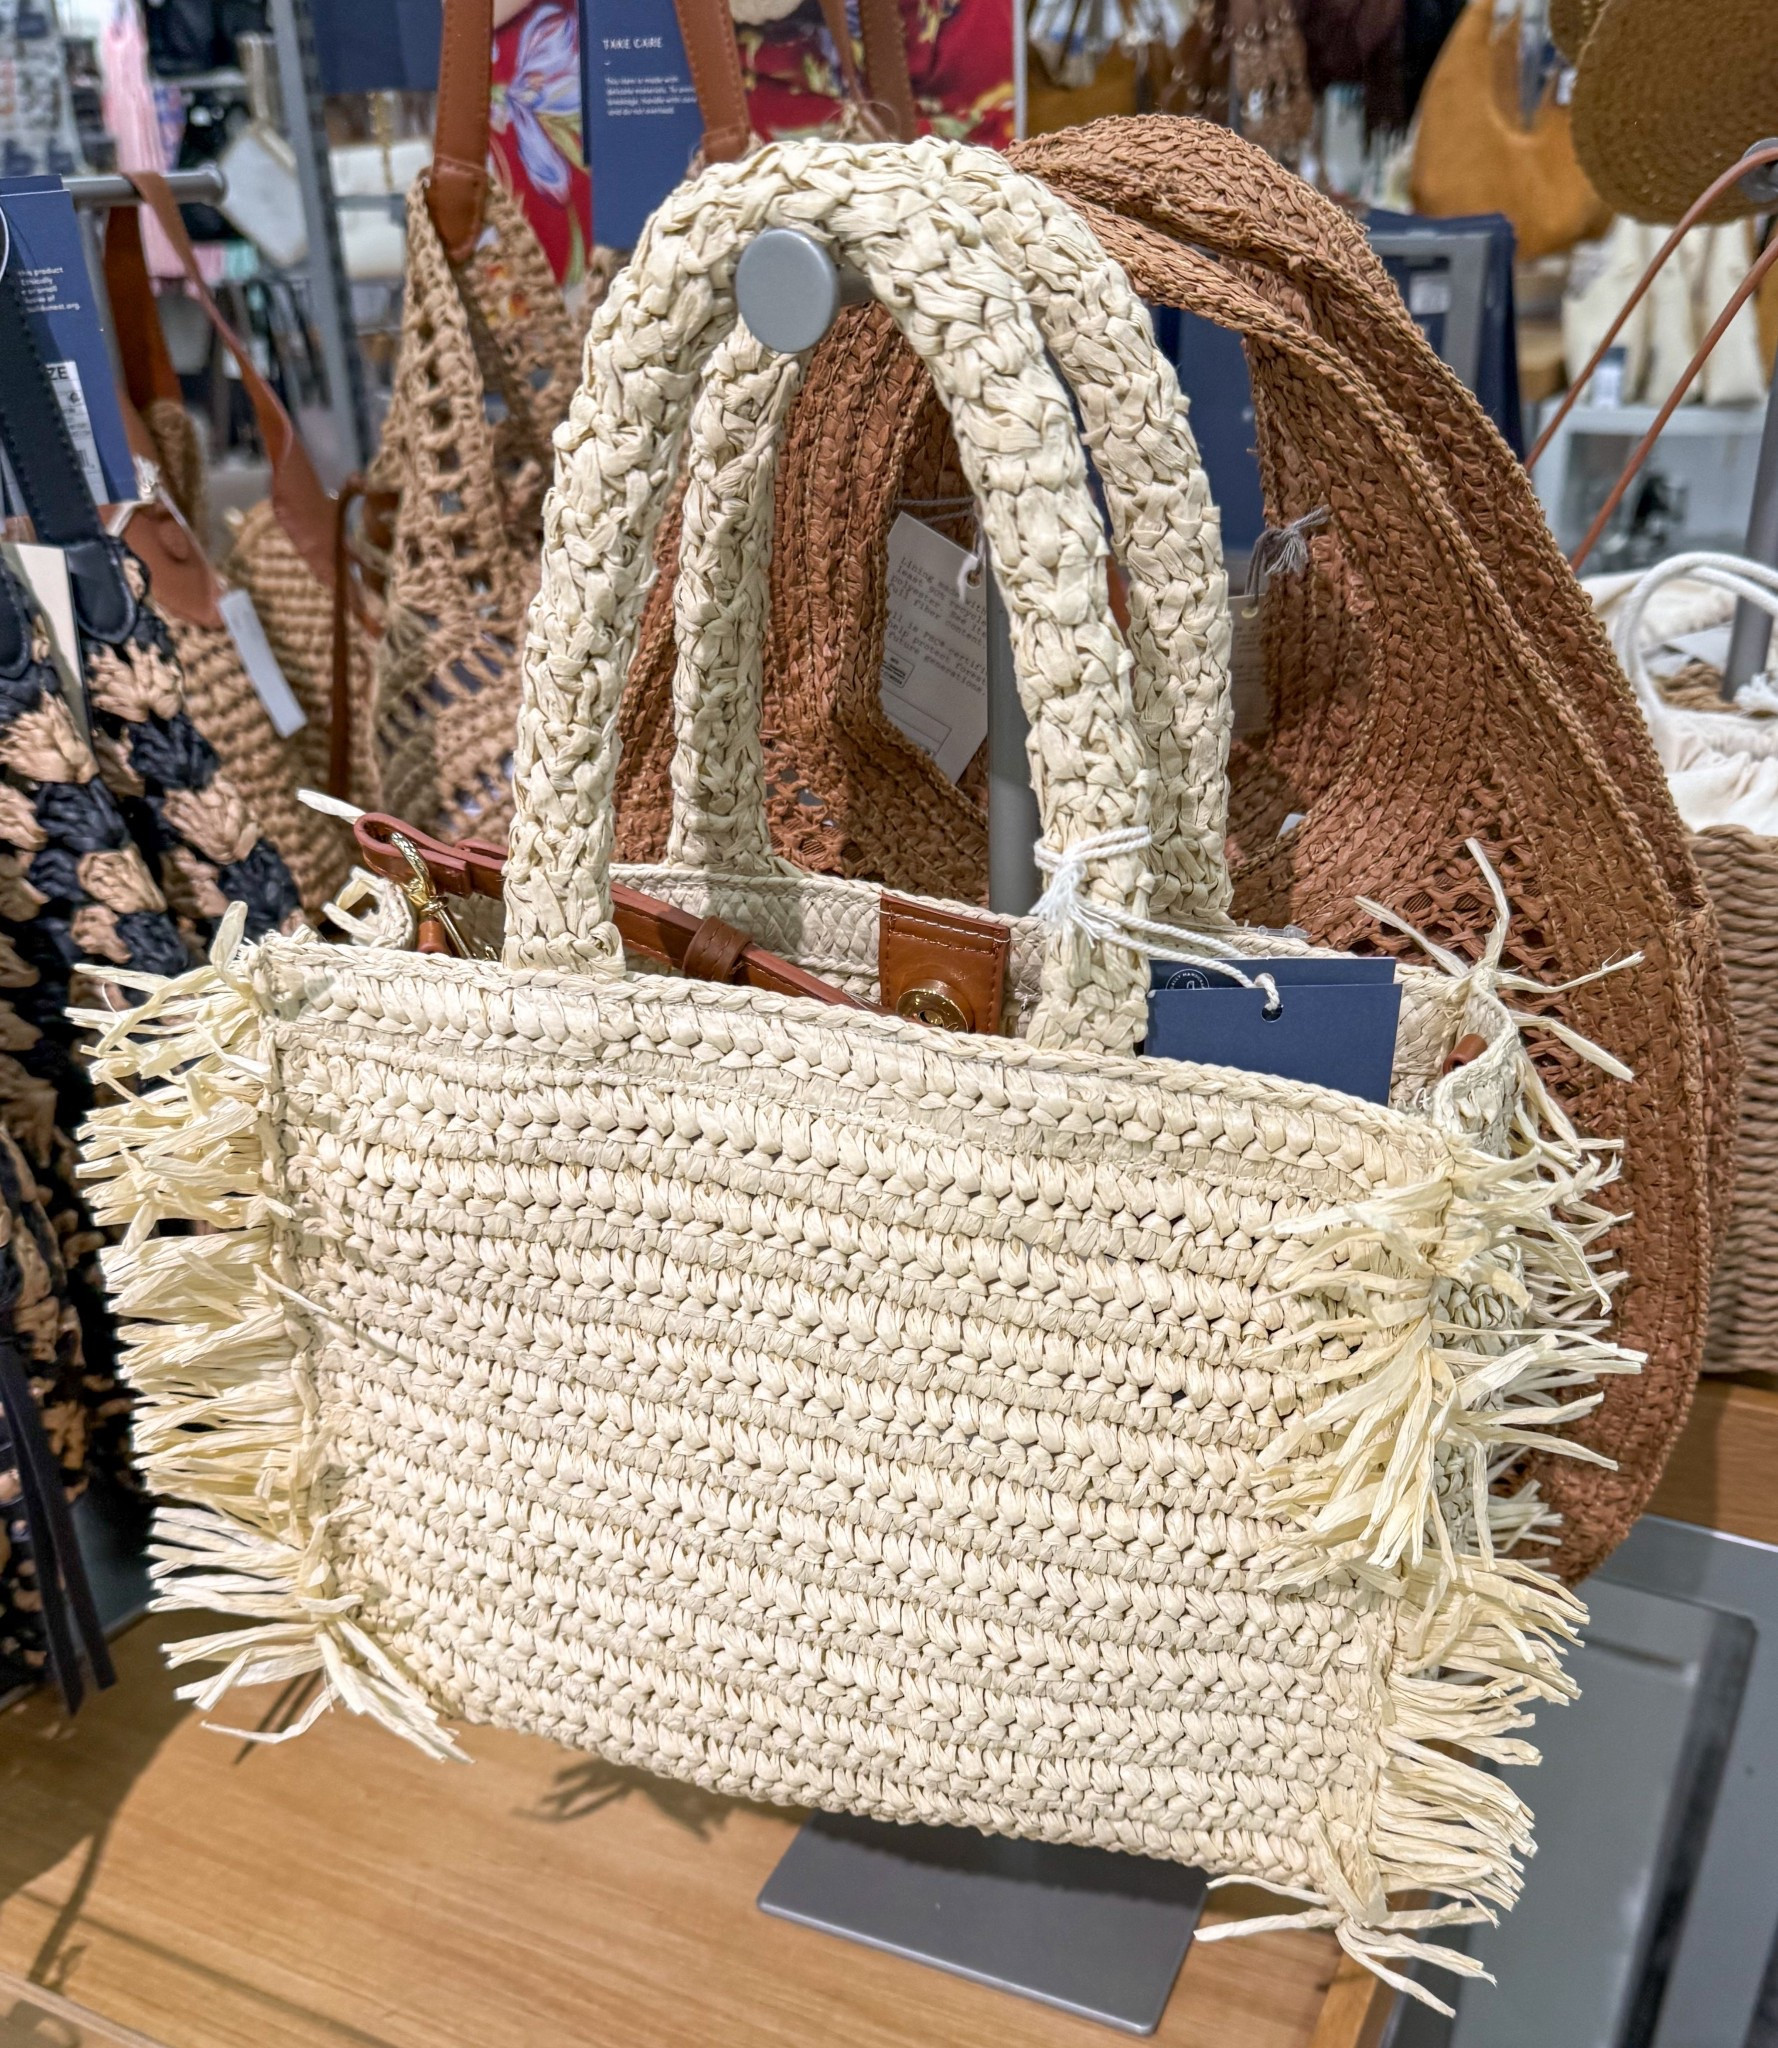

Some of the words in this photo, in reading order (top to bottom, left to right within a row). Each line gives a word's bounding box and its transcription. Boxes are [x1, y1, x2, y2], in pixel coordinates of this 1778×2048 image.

[602, 38, 631, 50] TAKE
[633, 36, 663, 48] CARE
[34, 267, 64, 276] product
[47, 366, 70, 381] ZE
[901, 557, 935, 584] Lining
[897, 565, 923, 587] least
[949, 600, 986, 626] recycle
[913, 600, 941, 619] fiber
[887, 630, 921, 655] future
[912, 637, 950, 663] protect
